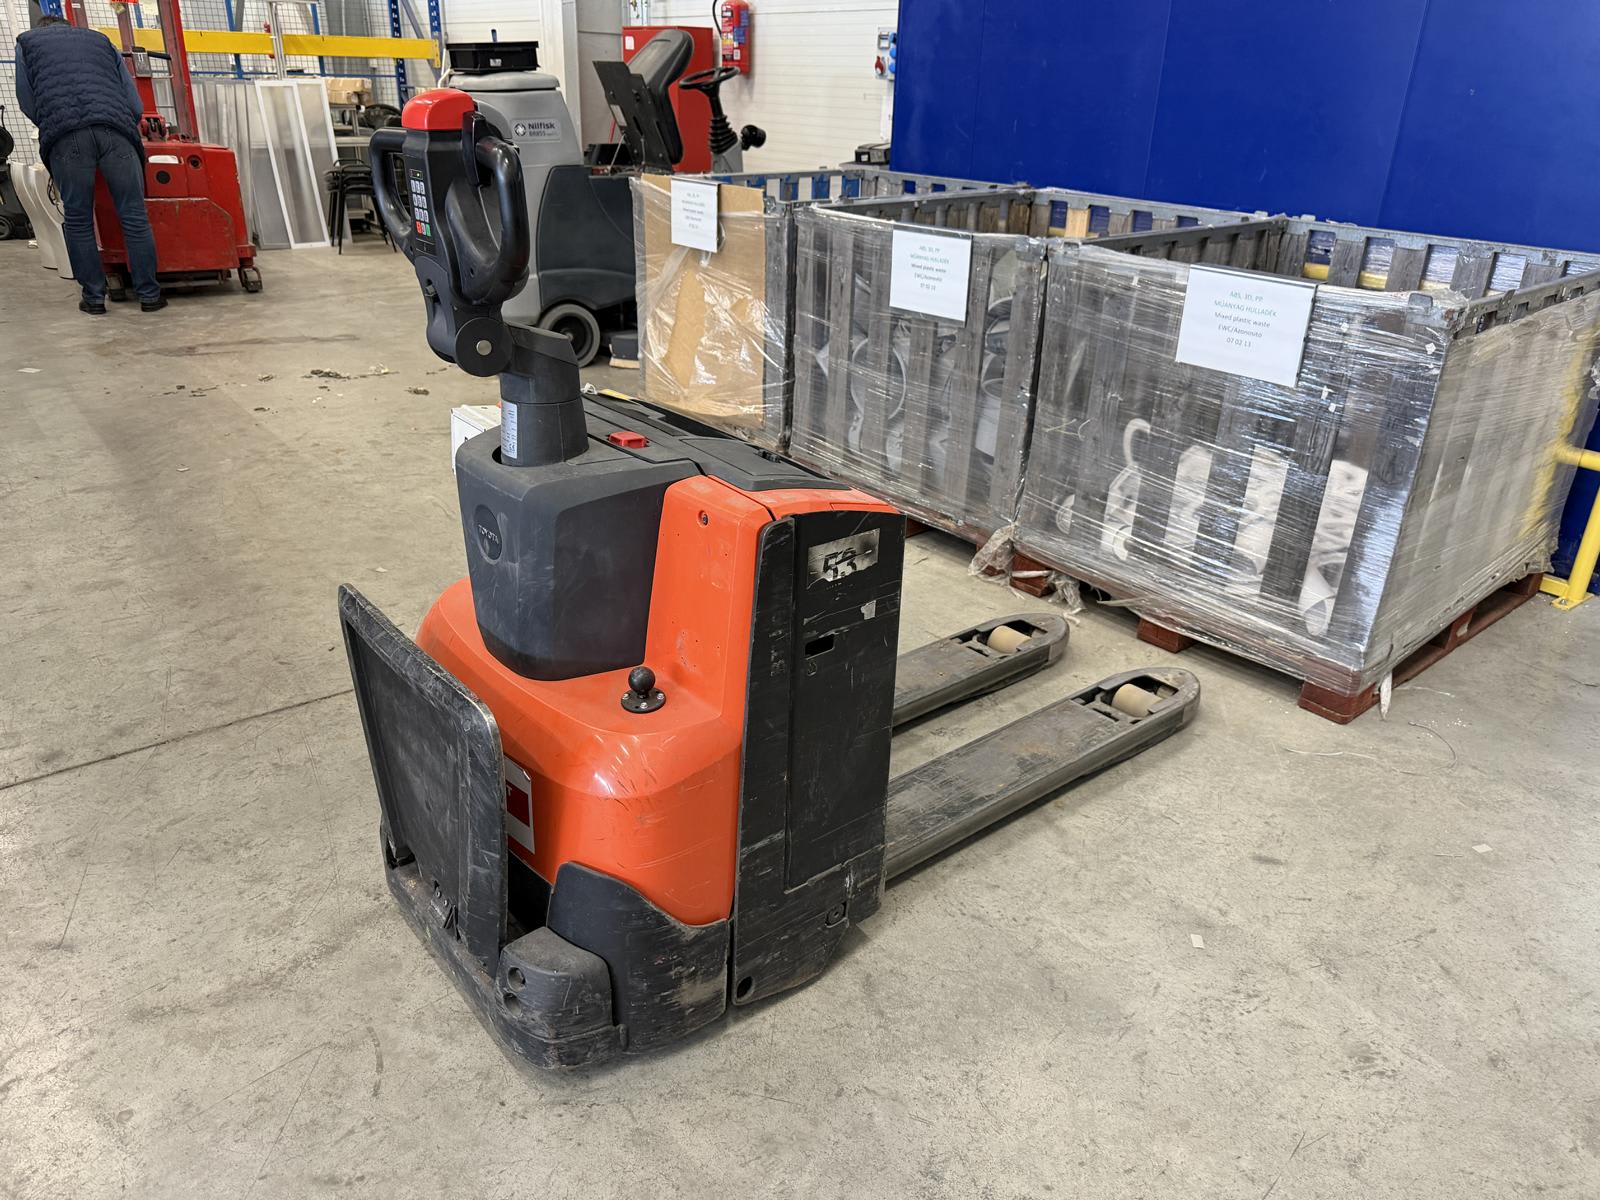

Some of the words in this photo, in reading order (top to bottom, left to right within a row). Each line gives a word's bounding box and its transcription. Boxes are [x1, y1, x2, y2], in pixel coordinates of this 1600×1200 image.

[528, 121, 556, 130] Nilfisk
[1255, 295, 1264, 303] PP
[1215, 312, 1232, 320] Mixed
[1233, 316, 1251, 324] plastic
[1234, 338, 1243, 346] 02
[478, 524, 499, 545] TOYOTA
